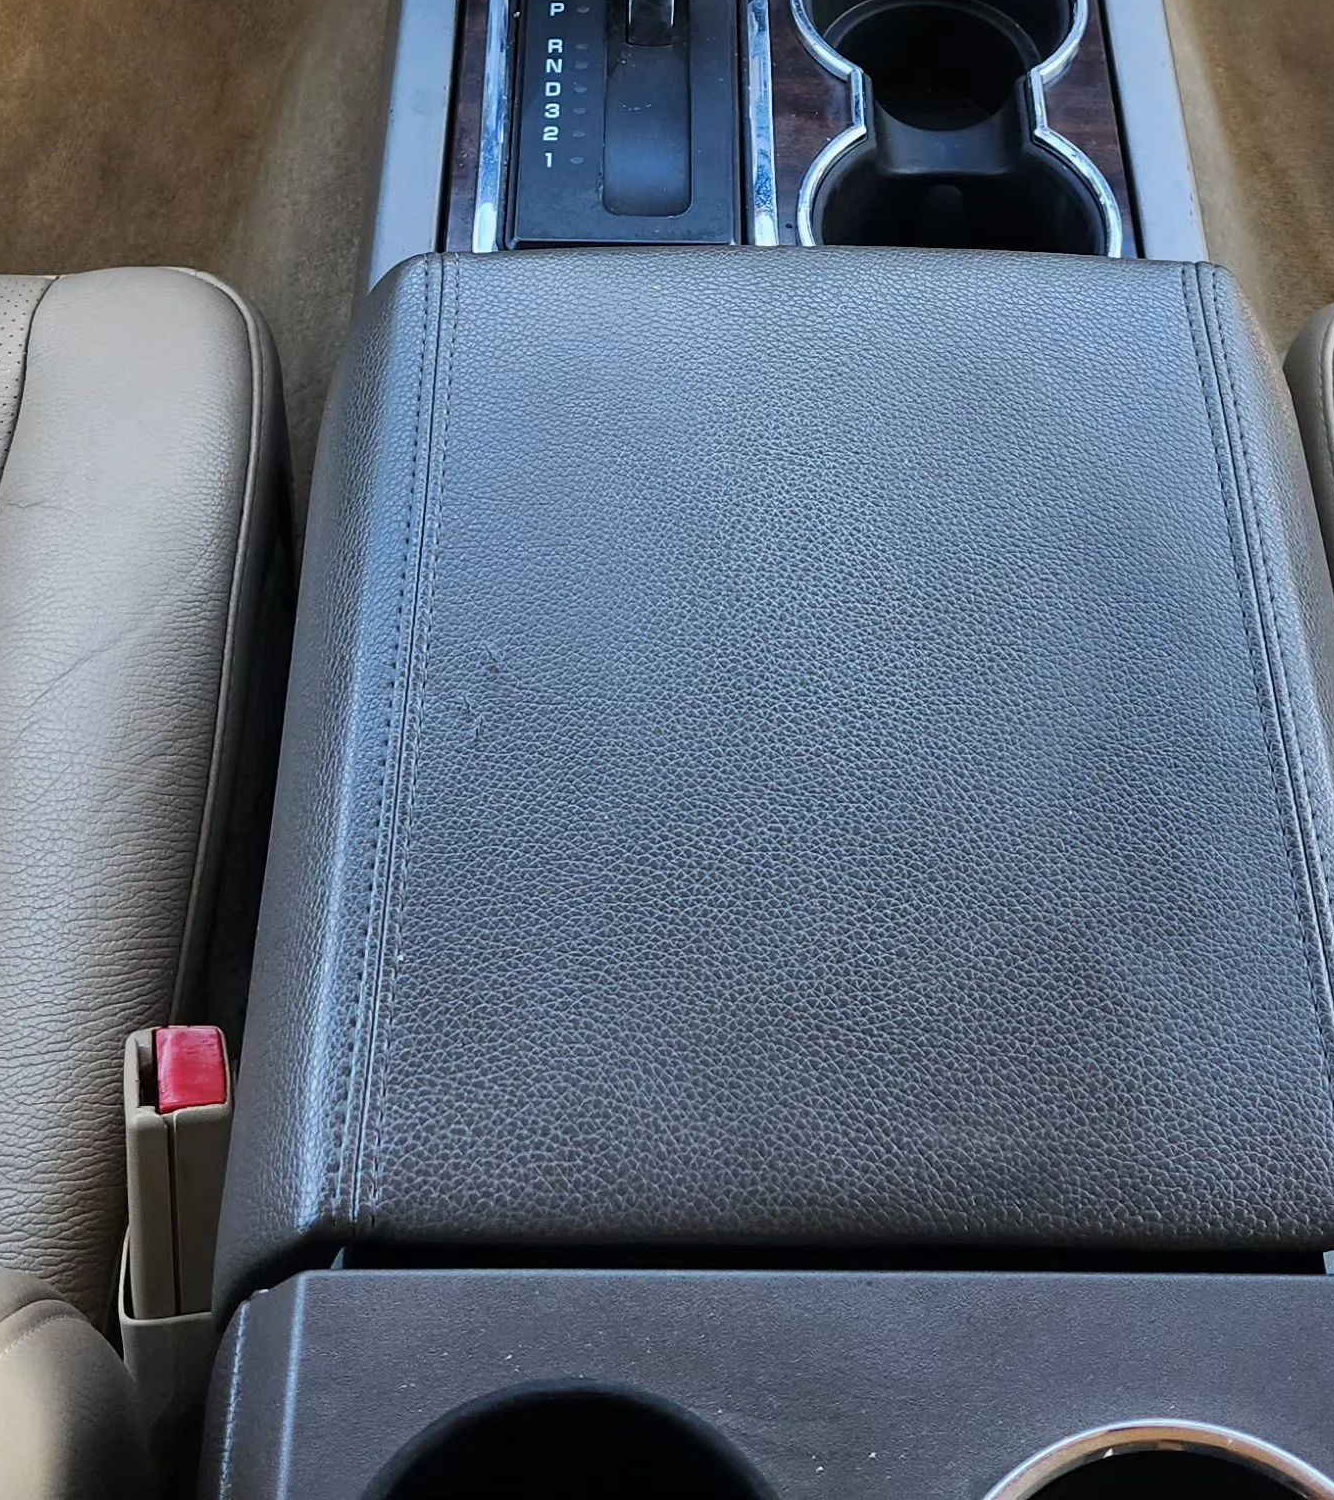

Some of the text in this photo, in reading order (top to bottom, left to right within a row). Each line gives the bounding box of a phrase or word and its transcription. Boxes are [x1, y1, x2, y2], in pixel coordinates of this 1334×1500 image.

[549, 2, 565, 17] P
[547, 38, 563, 53] R
[546, 58, 562, 74] N
[545, 82, 561, 97] D
[544, 103, 560, 118] 3
[543, 126, 559, 141] 2
[545, 152, 552, 168] 1
